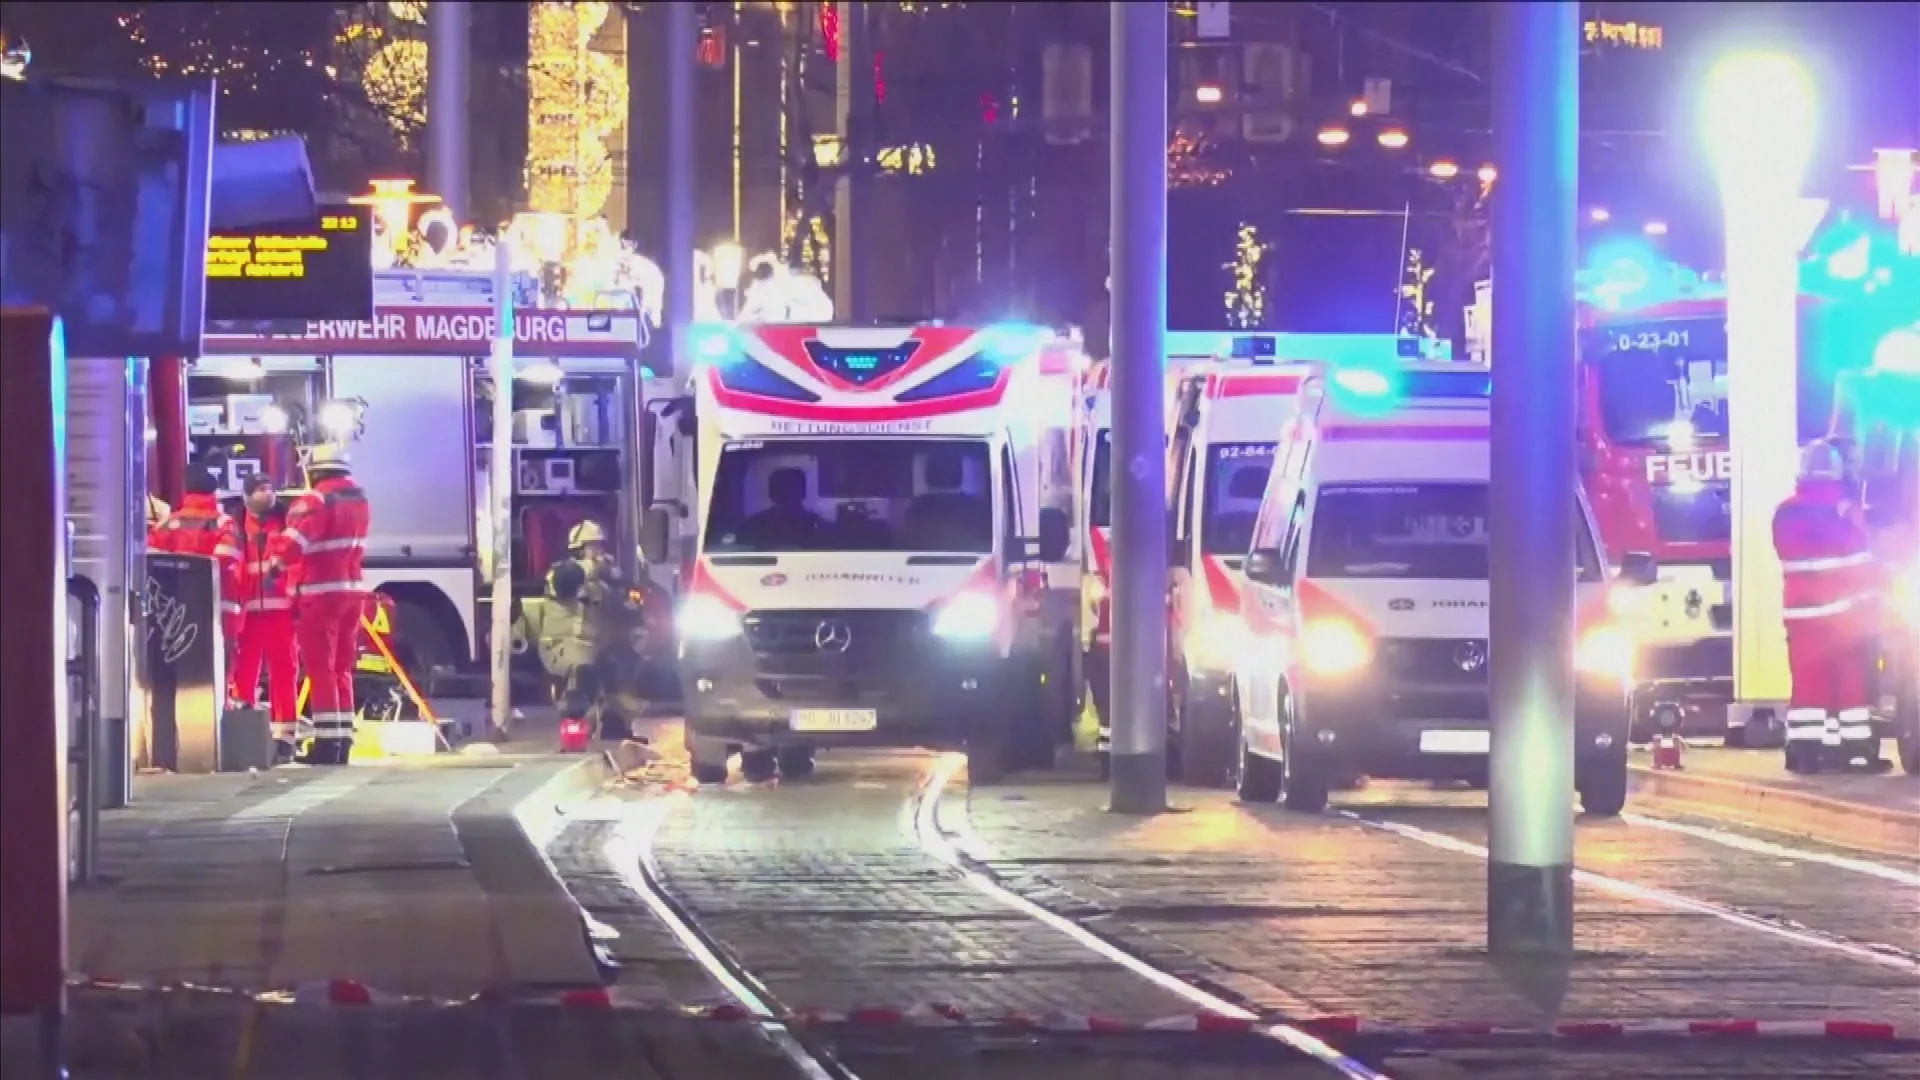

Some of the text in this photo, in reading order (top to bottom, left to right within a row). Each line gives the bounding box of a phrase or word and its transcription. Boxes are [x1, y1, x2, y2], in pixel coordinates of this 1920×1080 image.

[256, 314, 566, 342] ERWEHR MAGDEURG
[1610, 329, 1689, 351] 0-23-01
